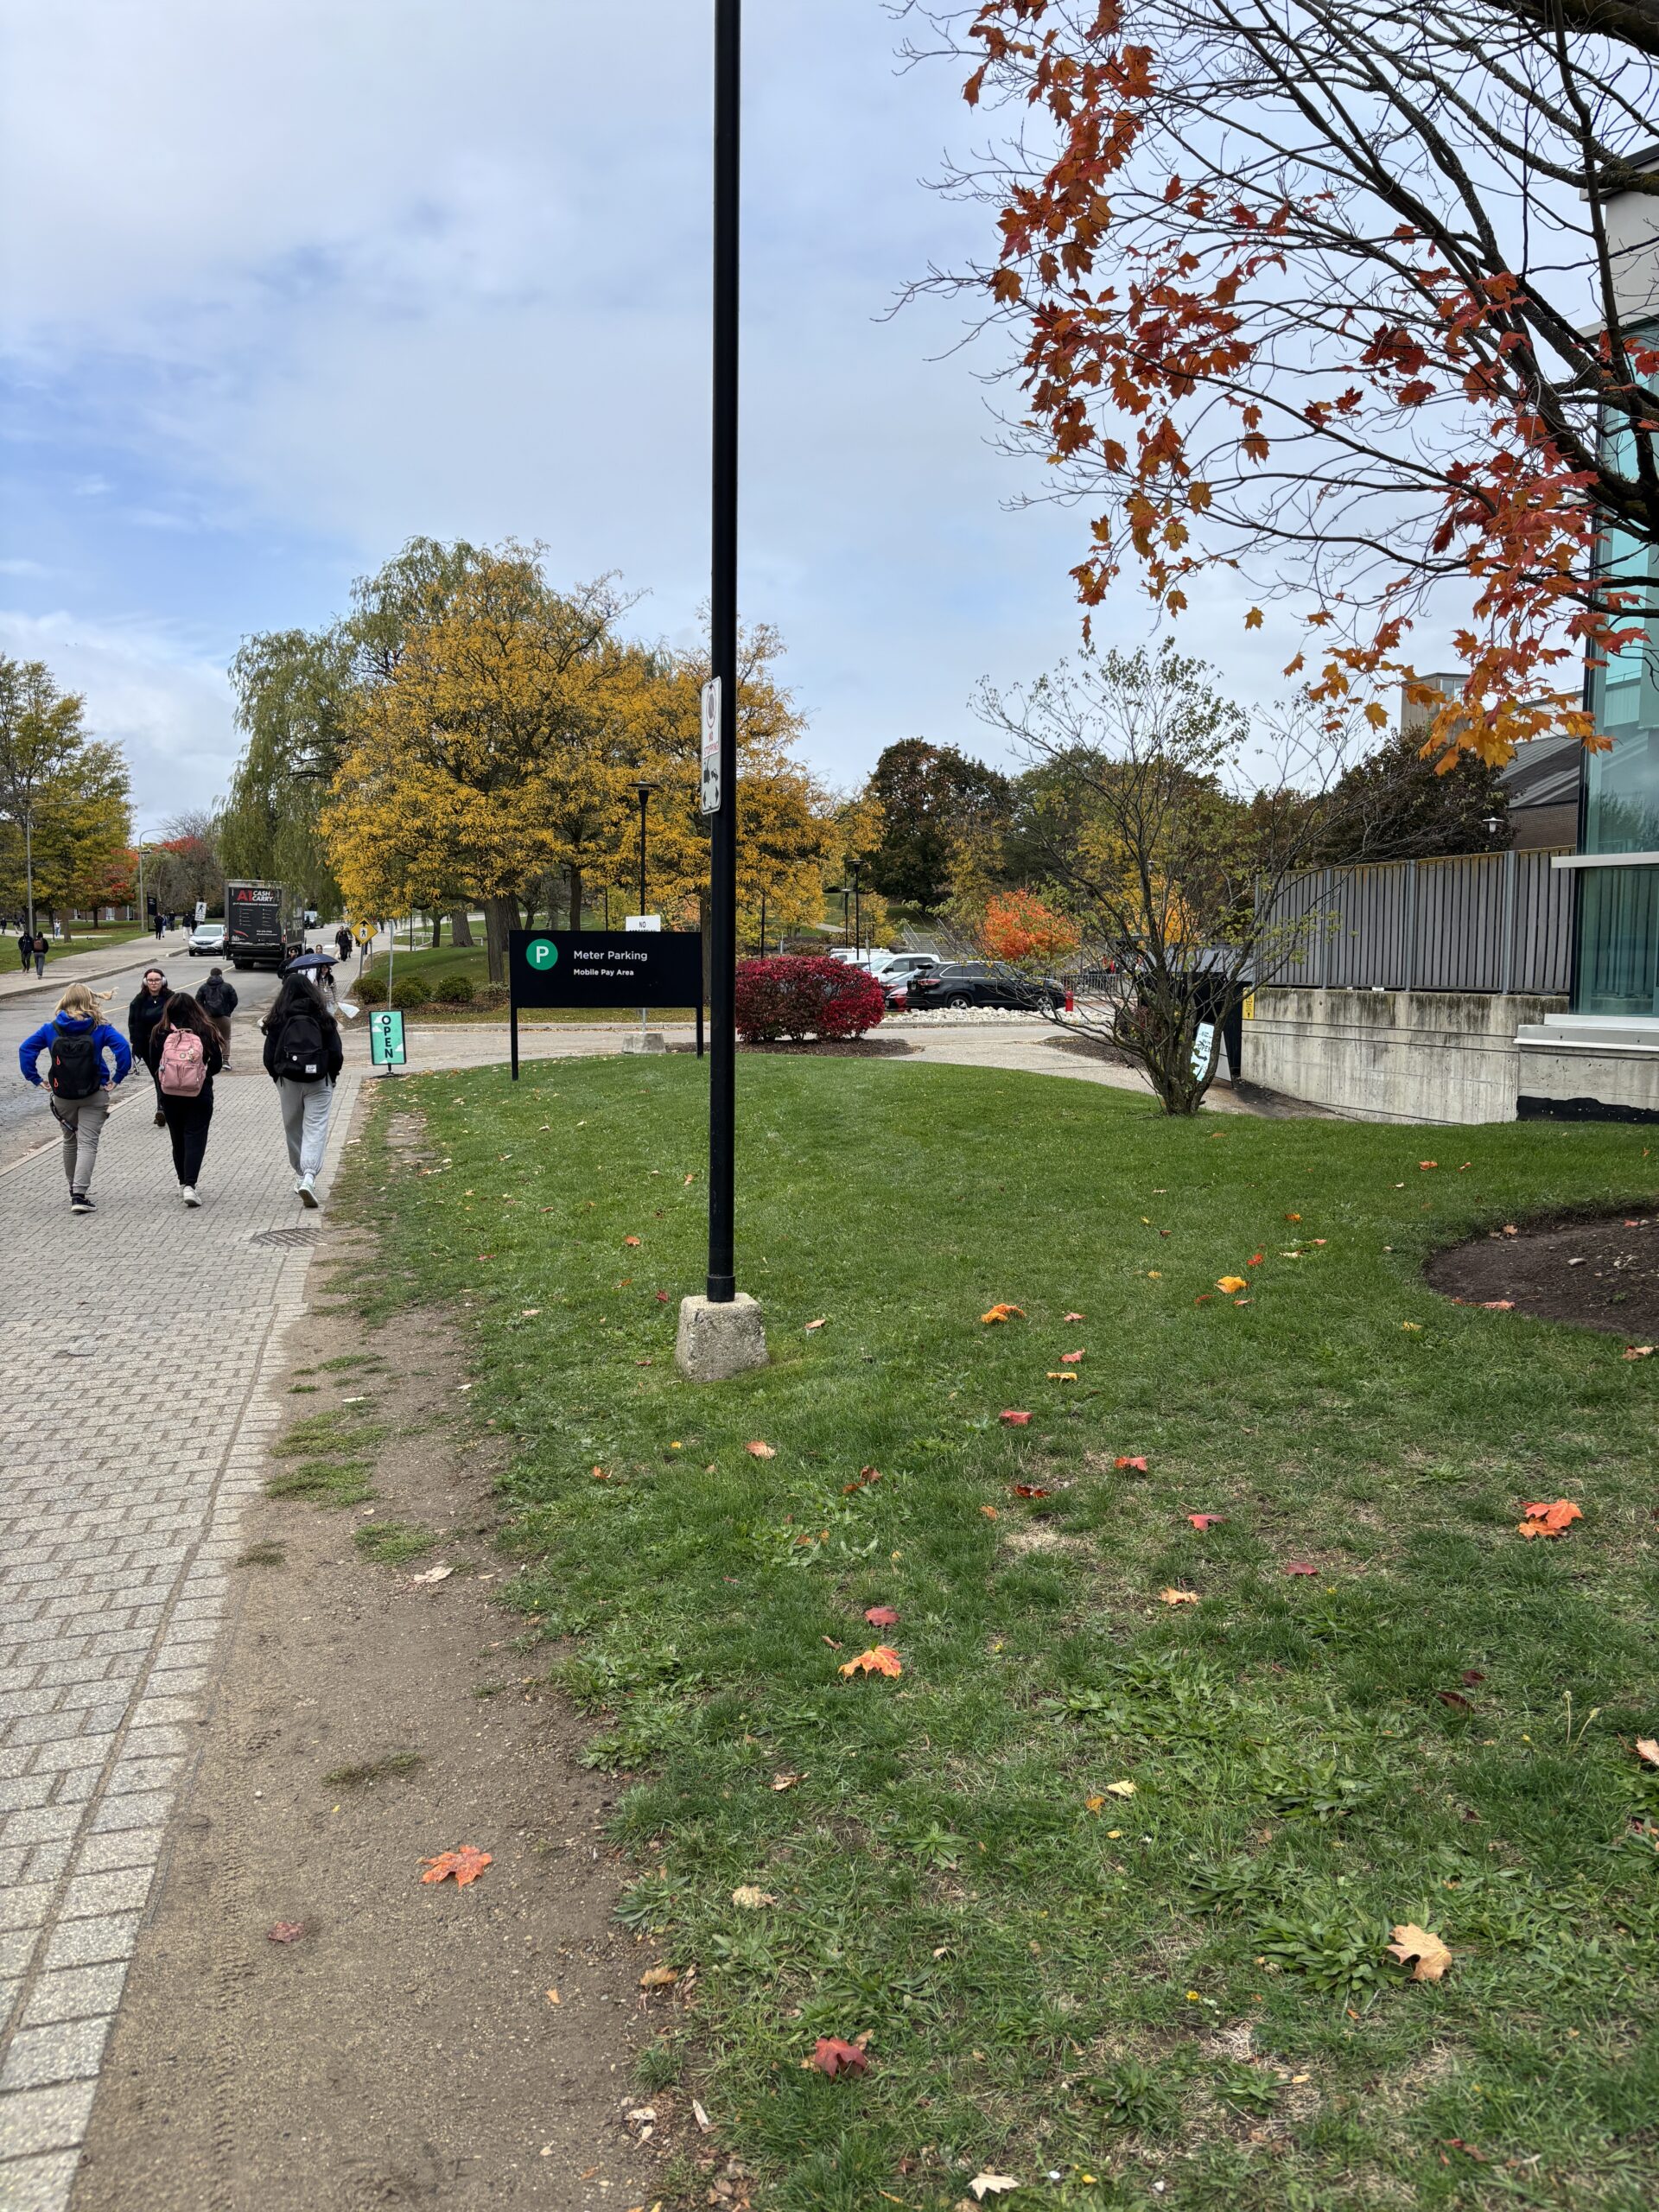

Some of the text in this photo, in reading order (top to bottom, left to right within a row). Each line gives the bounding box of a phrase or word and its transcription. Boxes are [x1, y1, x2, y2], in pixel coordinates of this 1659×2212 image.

[537, 946, 549, 963] P
[574, 950, 648, 962] Meter Parking
[382, 1014, 393, 1058] OPEN
